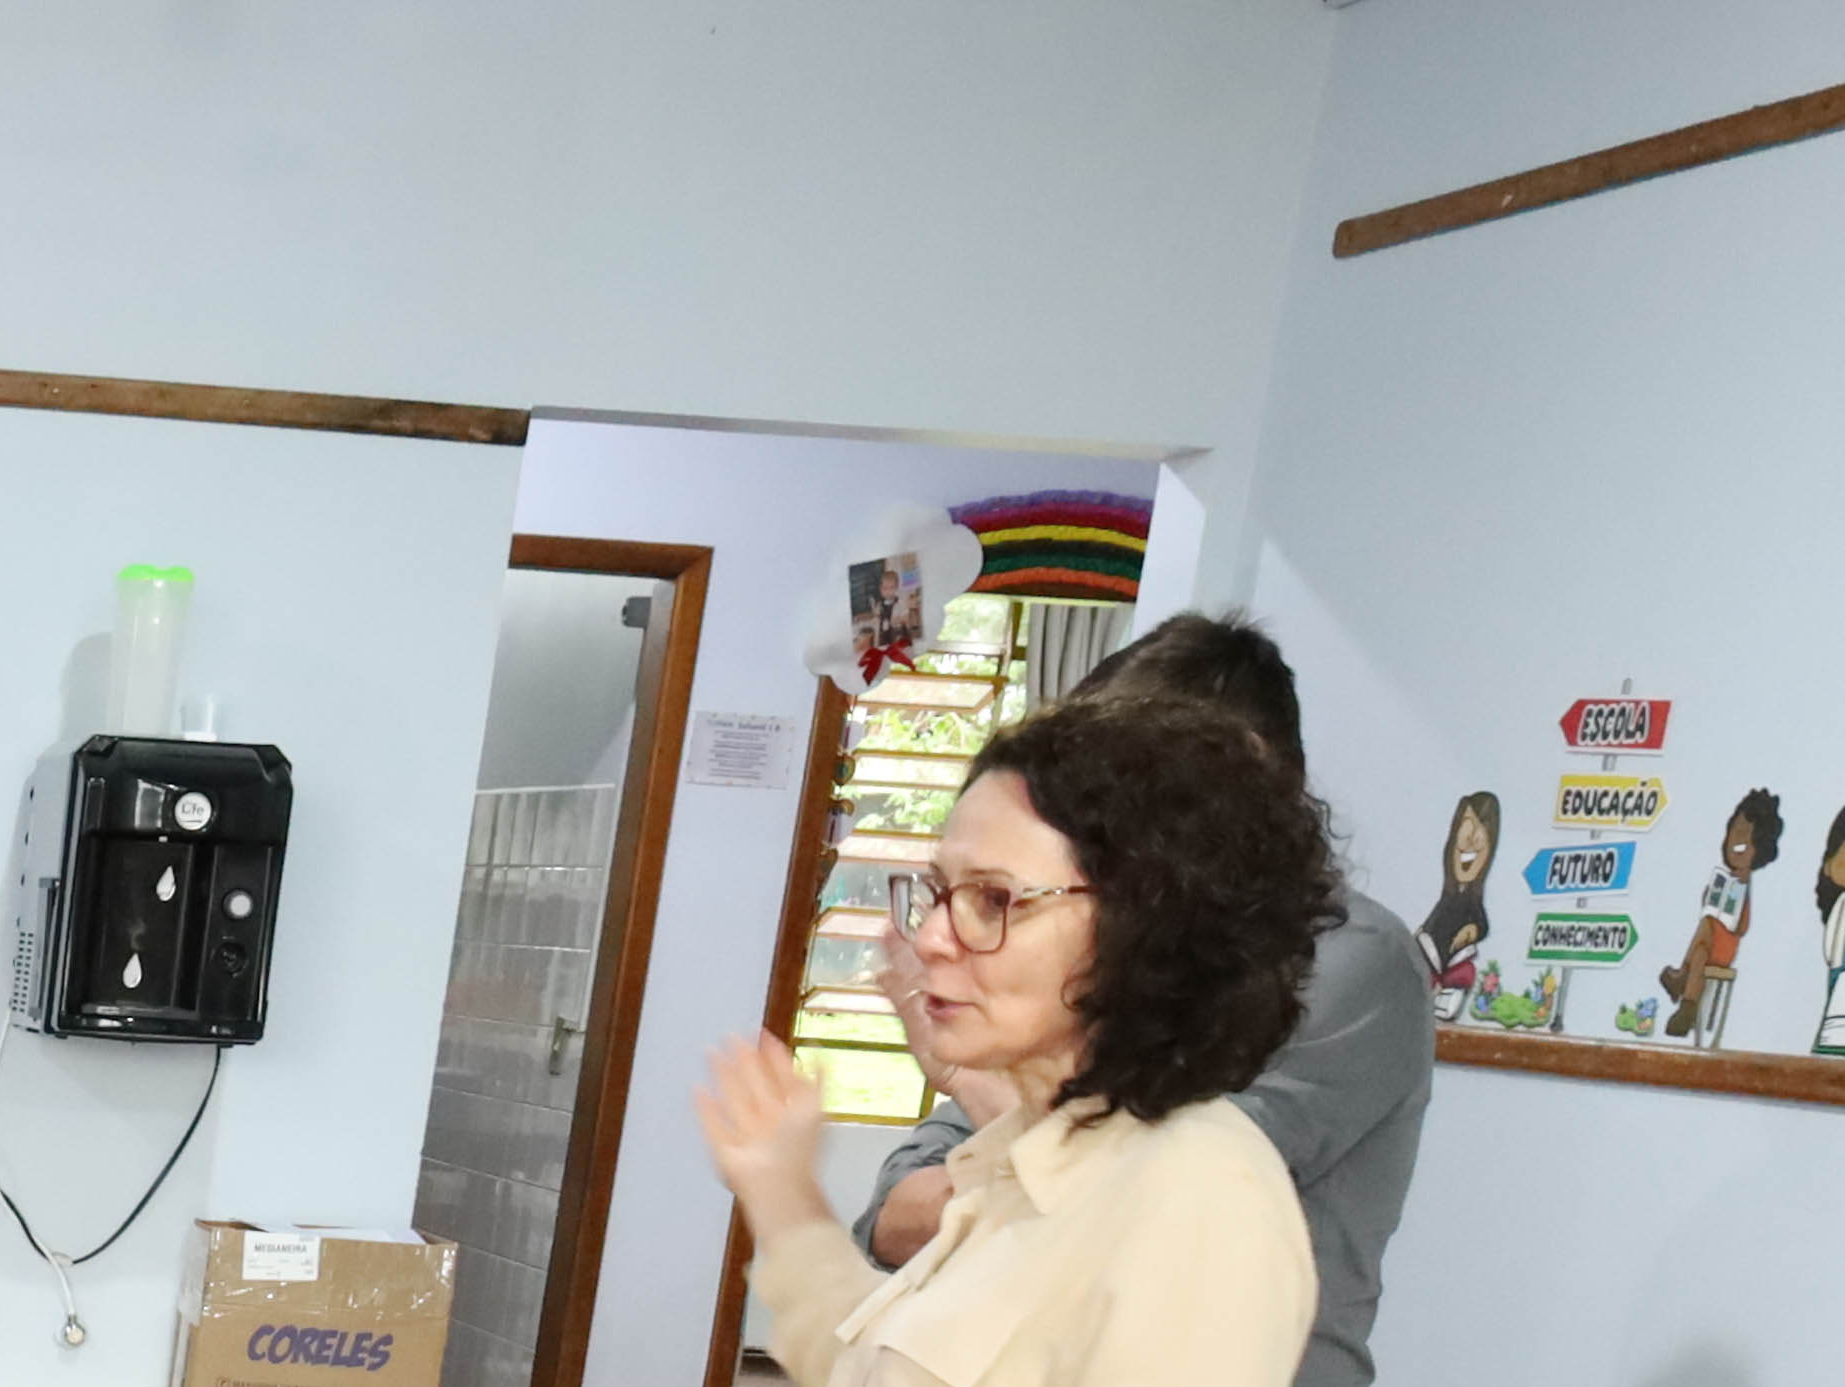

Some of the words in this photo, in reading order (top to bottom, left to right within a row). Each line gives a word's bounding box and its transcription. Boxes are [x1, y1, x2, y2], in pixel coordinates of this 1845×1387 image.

[1580, 704, 1648, 742] ESCOLA
[1561, 781, 1659, 821] EDUCAÇÃO
[1548, 851, 1615, 887] FUTURO
[1532, 924, 1628, 950] CONHECIMENTO
[247, 1324, 394, 1372] CORELES
